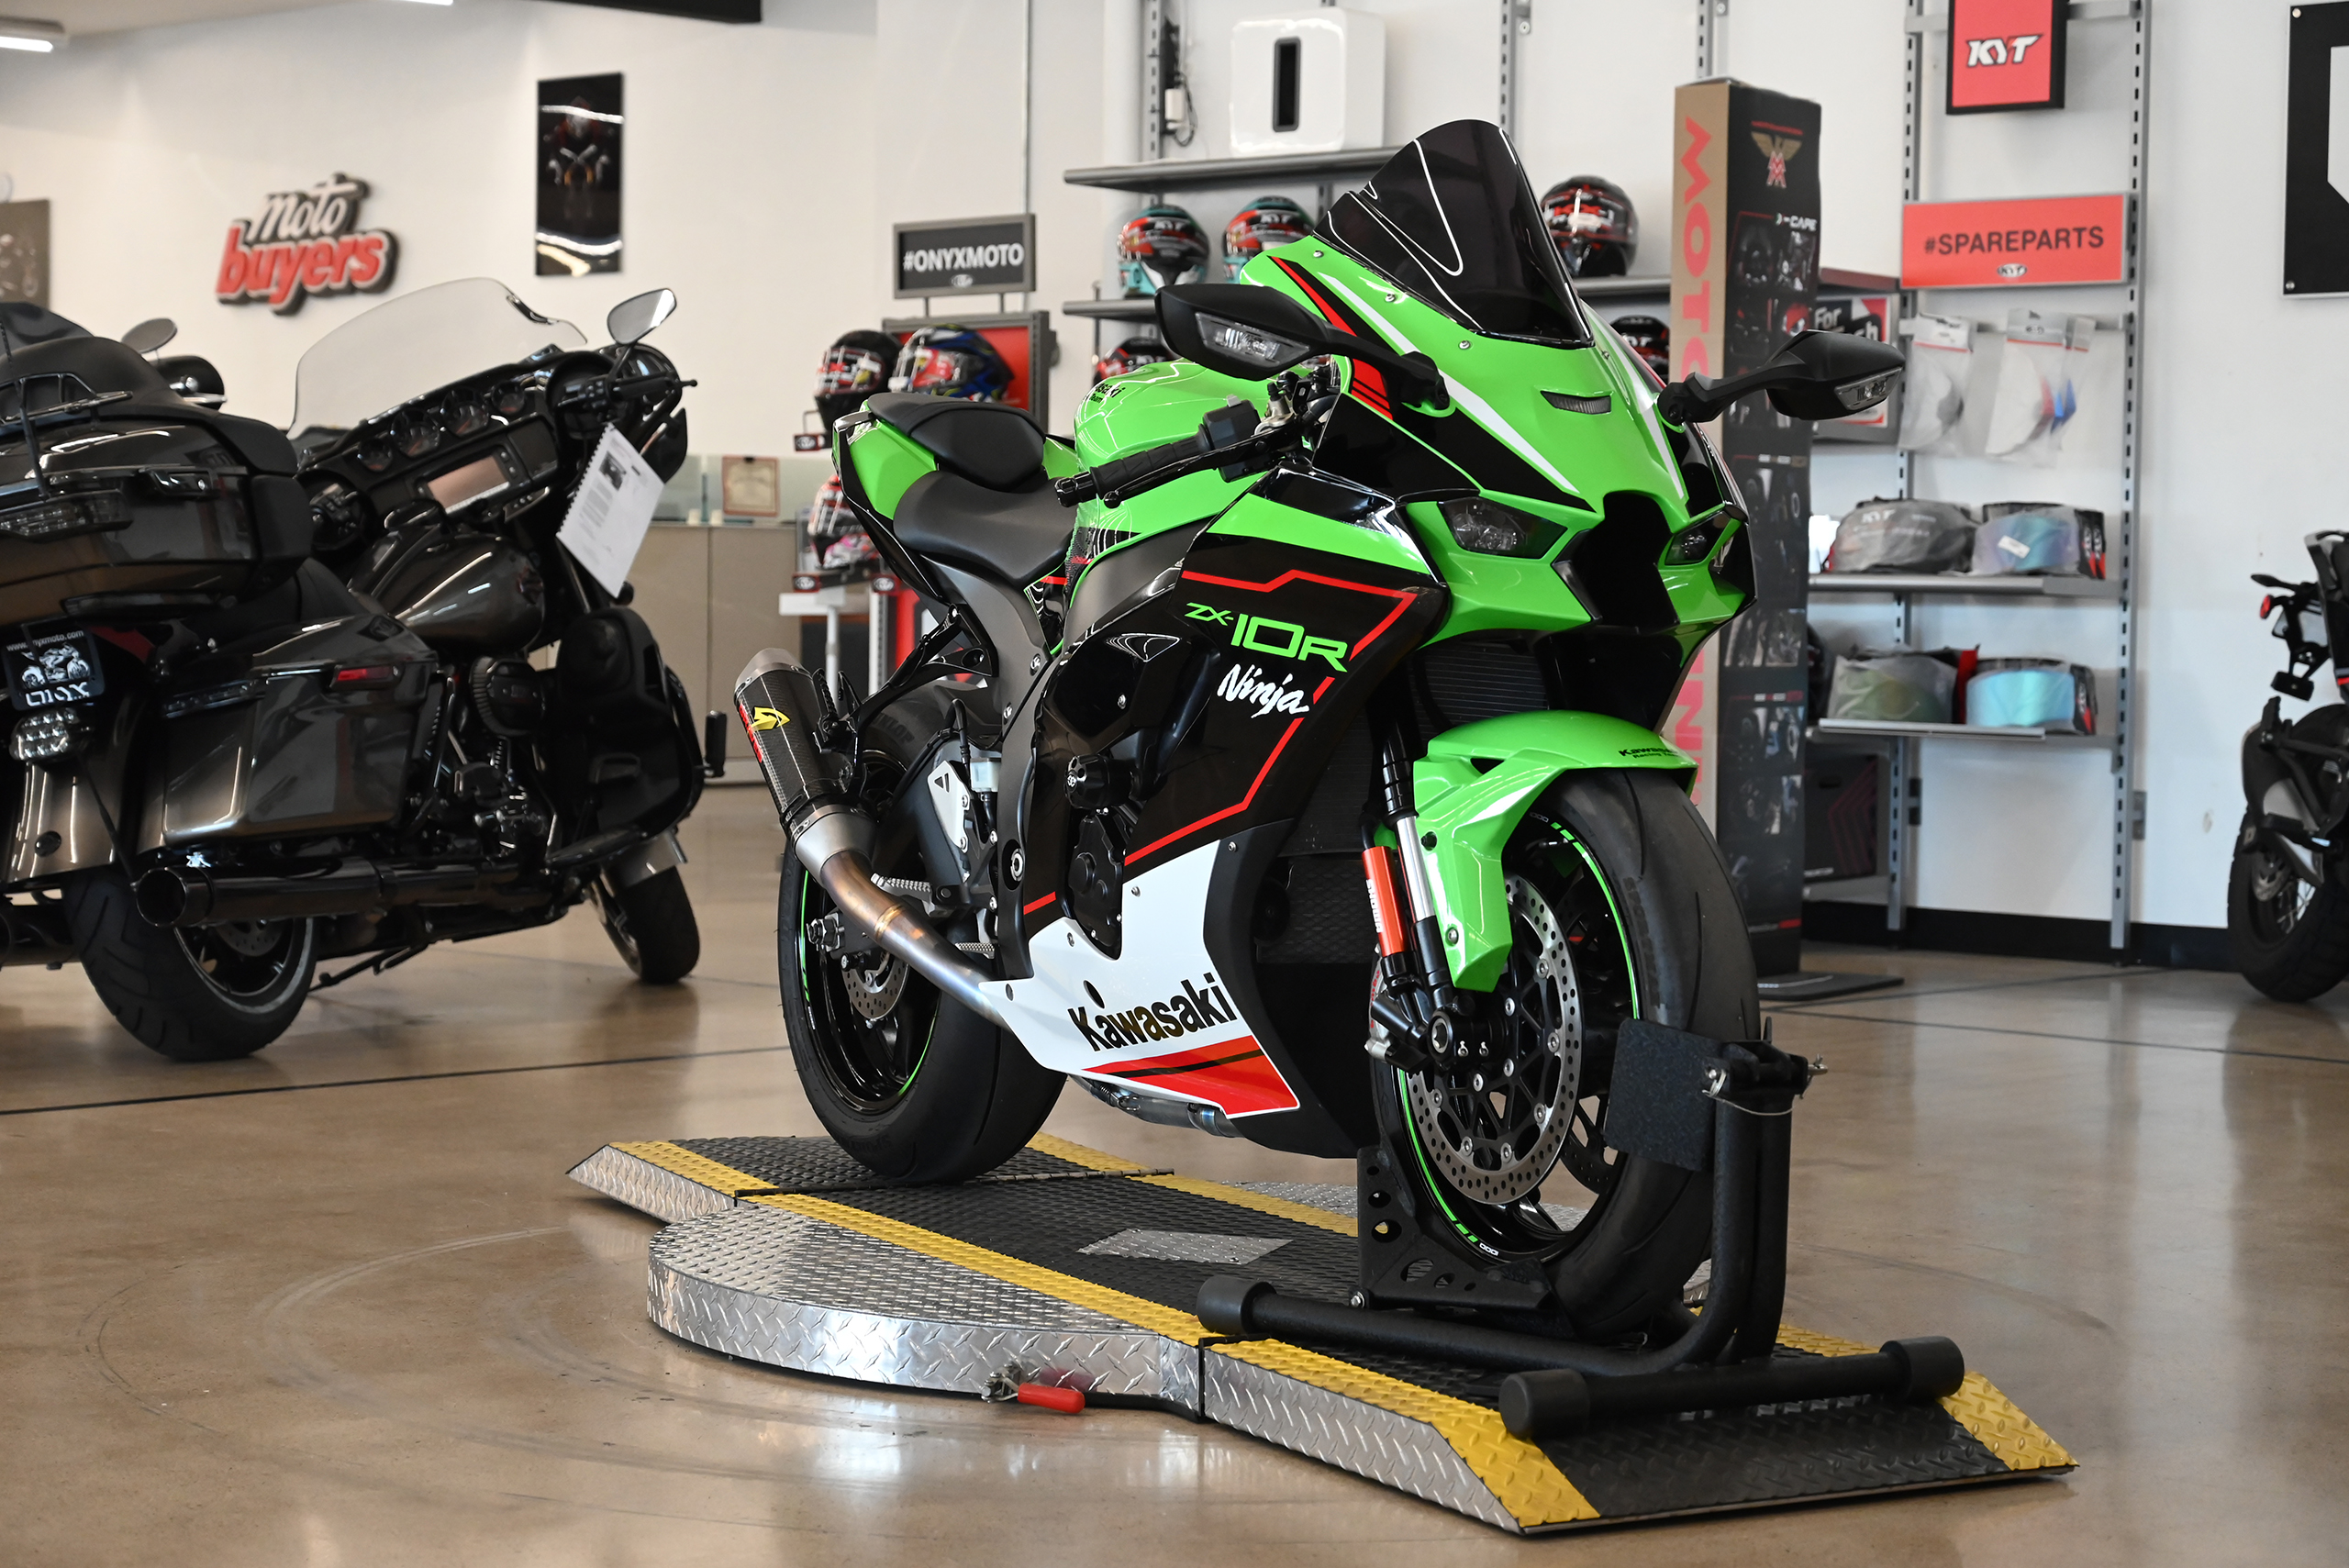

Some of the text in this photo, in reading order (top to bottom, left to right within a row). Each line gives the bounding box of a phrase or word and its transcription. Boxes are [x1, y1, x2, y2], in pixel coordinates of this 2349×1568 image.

[1966, 34, 2042, 68] KYT
[903, 242, 1025, 272] #ONYXMOTO
[1924, 226, 2104, 255] #SPAREPARTS
[216, 224, 387, 306] buyers
[6, 629, 84, 652] www.nyxmoto.com
[1185, 602, 1348, 673] ZX-10R
[1217, 663, 1310, 719] Ninja
[1067, 972, 1238, 1051] Kawasaki
